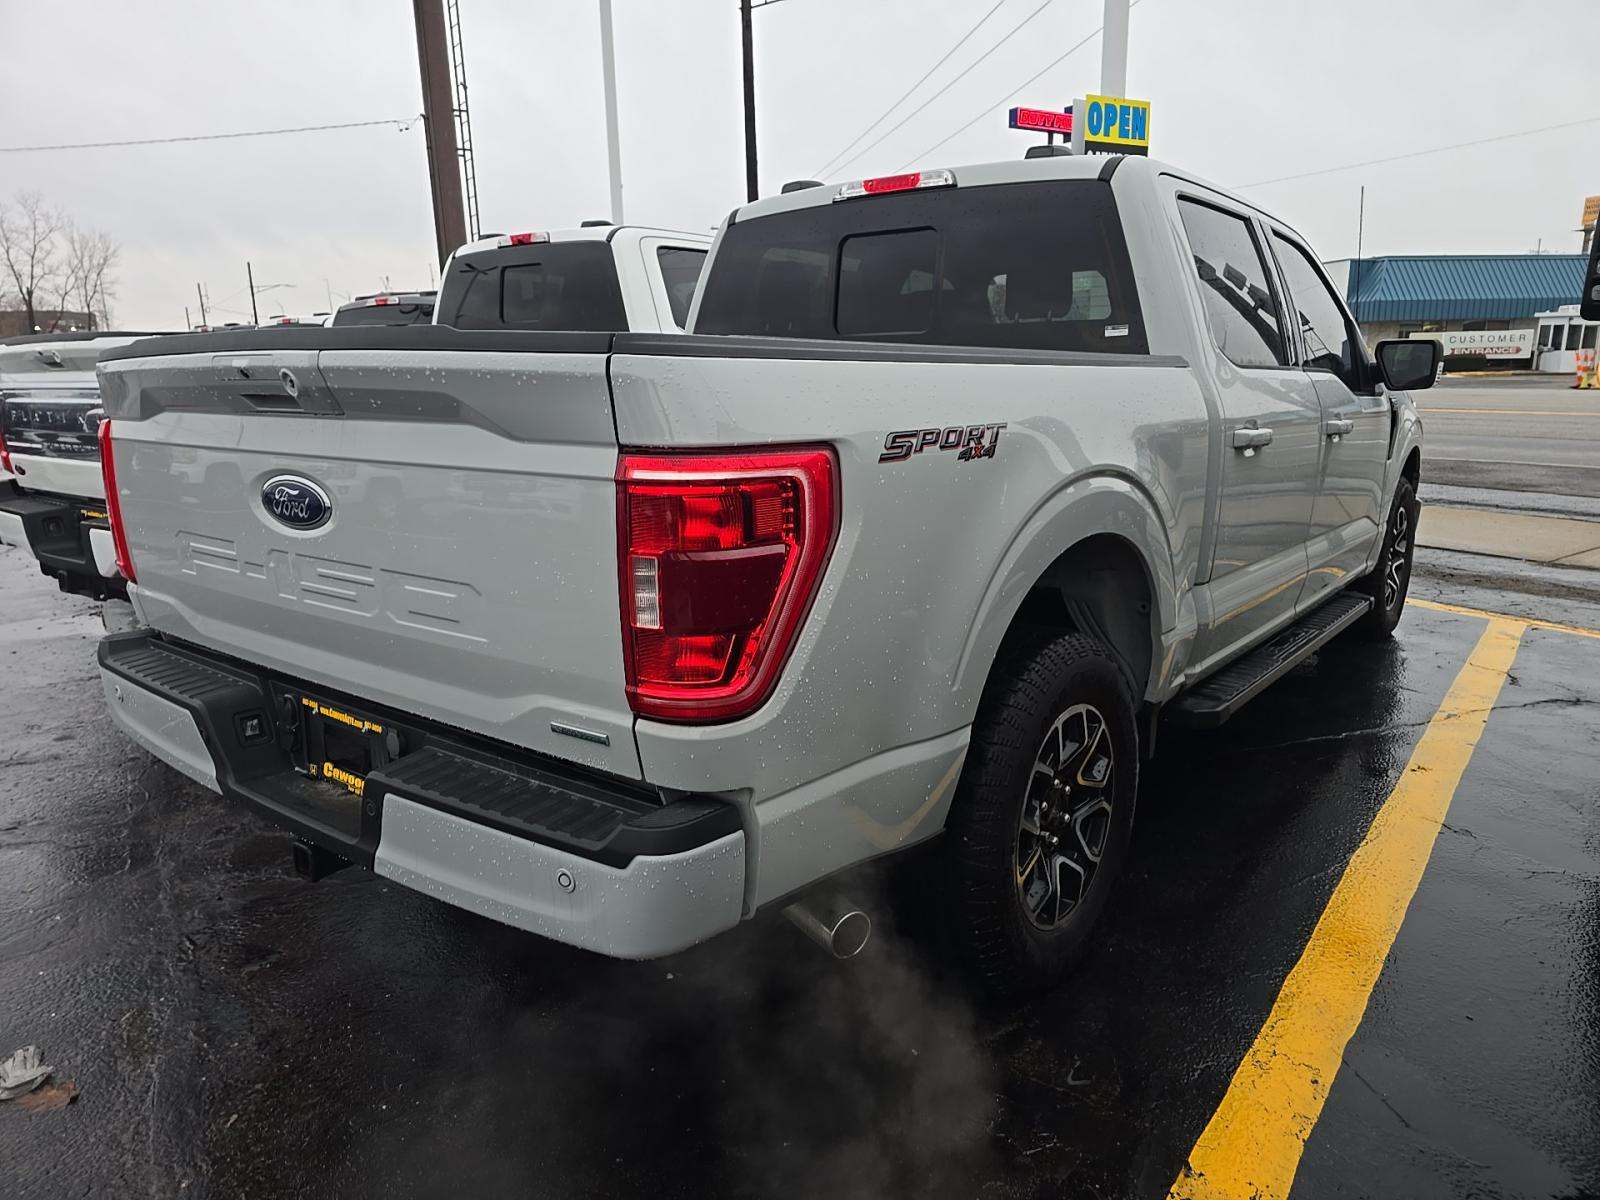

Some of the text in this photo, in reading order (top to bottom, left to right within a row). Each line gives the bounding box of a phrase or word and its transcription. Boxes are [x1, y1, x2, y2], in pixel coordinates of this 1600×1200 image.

[1088, 101, 1147, 140] OPEN
[1449, 333, 1527, 344] CUSTOMER
[1454, 346, 1517, 356] ENTRANCE
[878, 422, 1008, 464] SPORT
[272, 486, 311, 519] Ford
